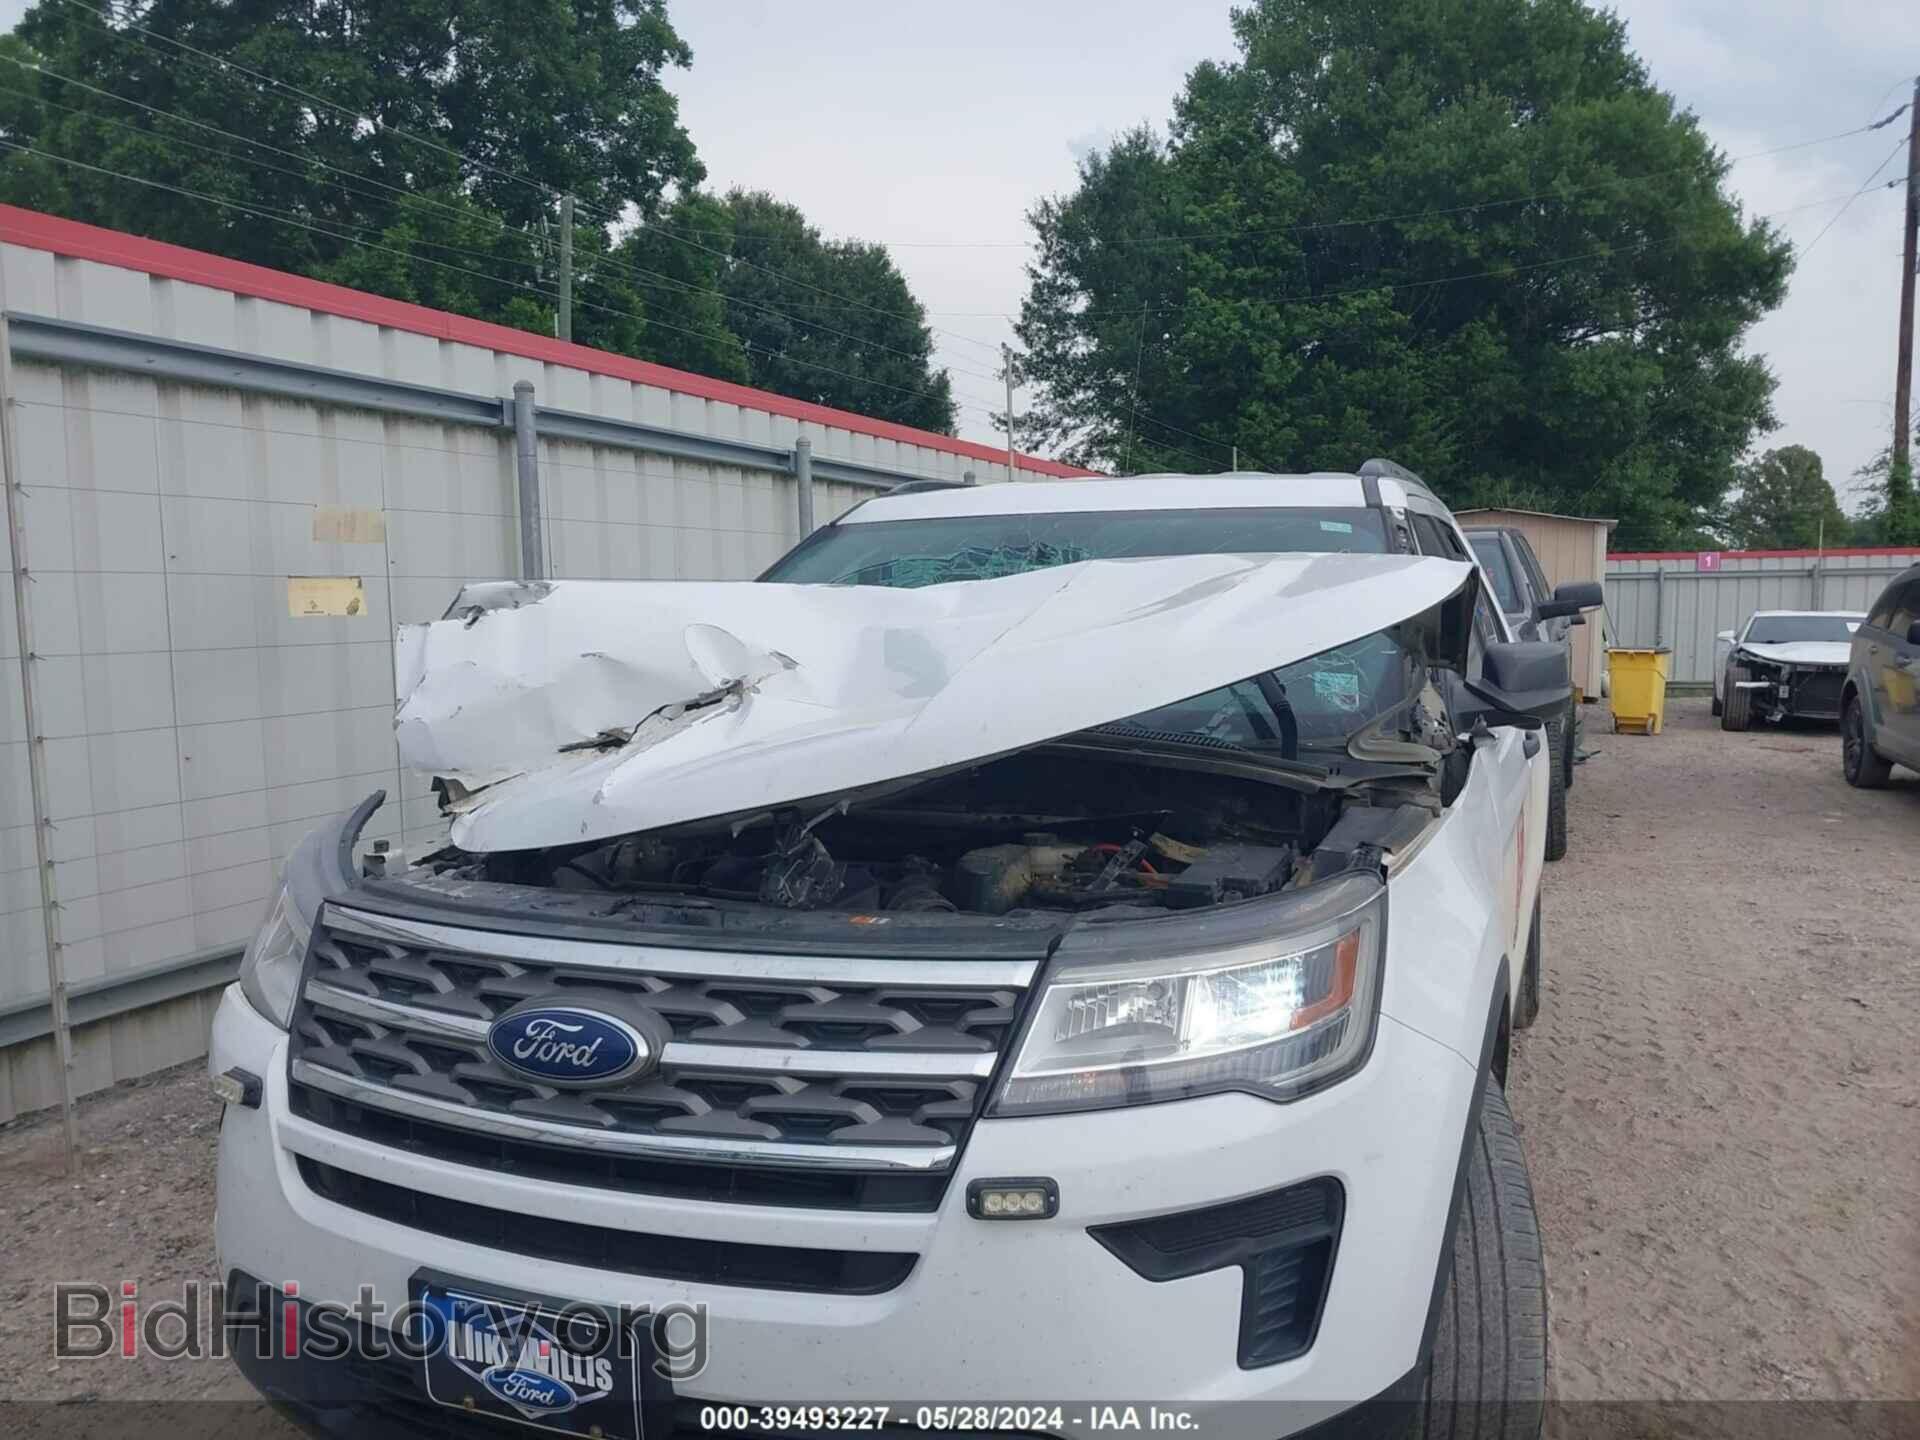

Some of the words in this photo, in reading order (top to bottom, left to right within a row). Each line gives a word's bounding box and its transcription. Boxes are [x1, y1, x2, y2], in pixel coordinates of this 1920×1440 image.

[513, 1019, 602, 1067] Ford
[515, 1333, 613, 1391] WILLIS
[503, 1371, 555, 1406] Ford
